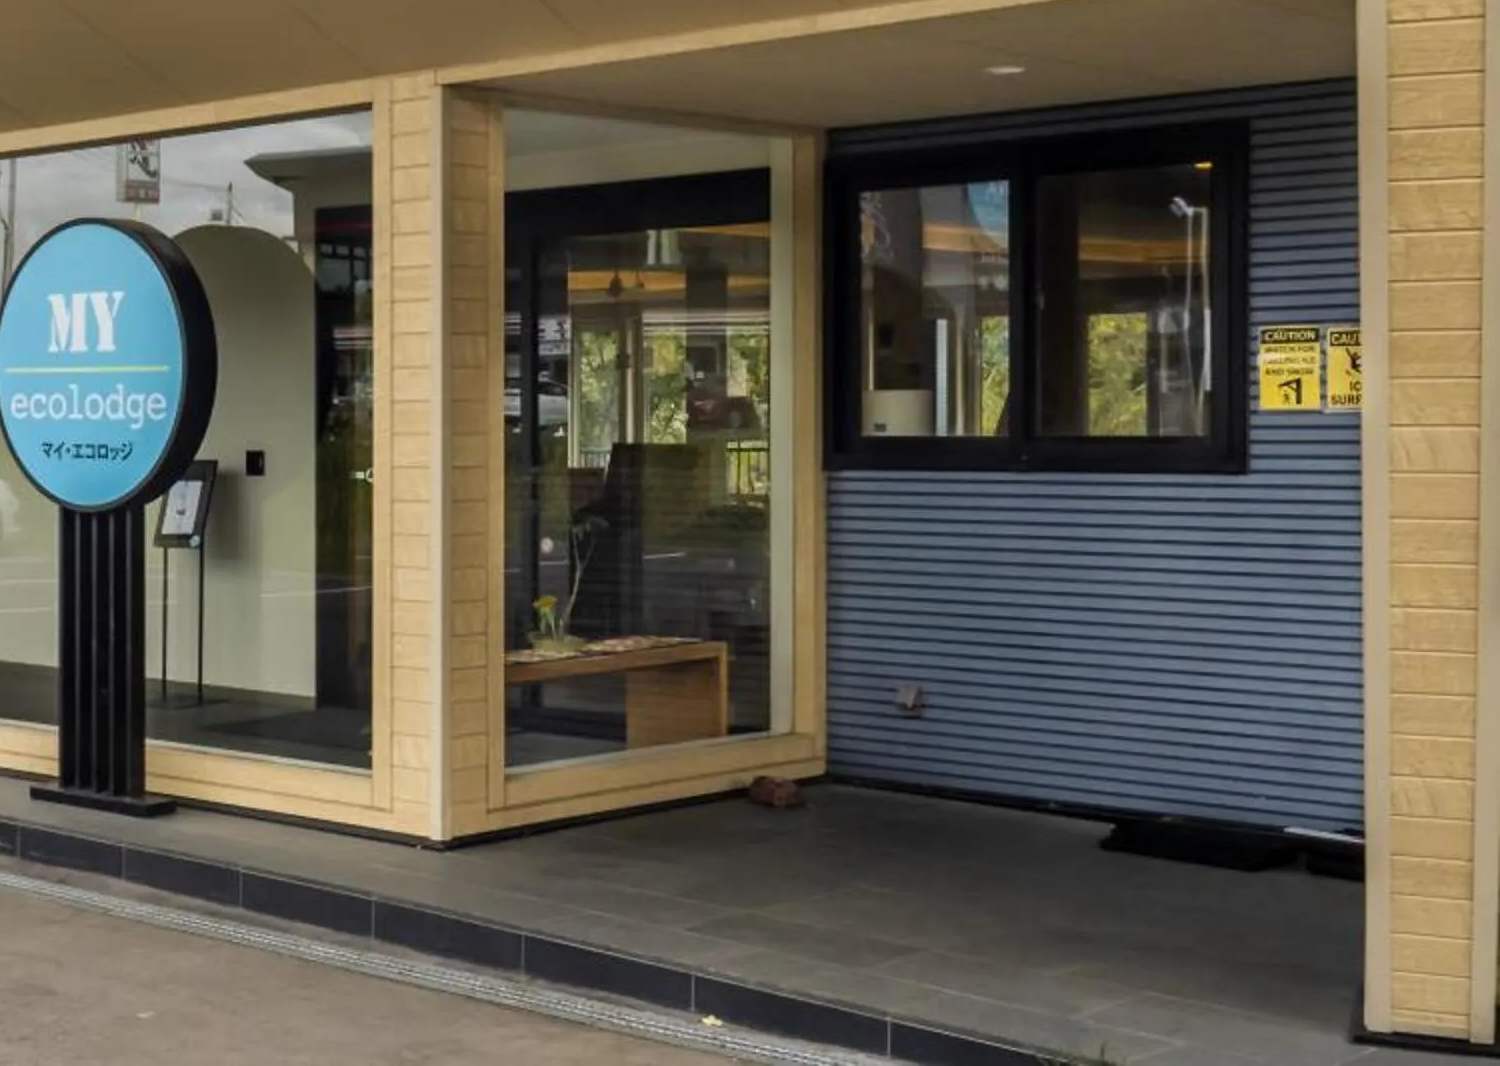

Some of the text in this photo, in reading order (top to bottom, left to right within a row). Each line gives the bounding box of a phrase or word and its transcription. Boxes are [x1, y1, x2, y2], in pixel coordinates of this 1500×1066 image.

[47, 290, 126, 354] MY
[1264, 330, 1316, 342] CAUTION
[10, 384, 167, 430] ecolodge
[41, 440, 134, 462] マイ・エコロッジ
